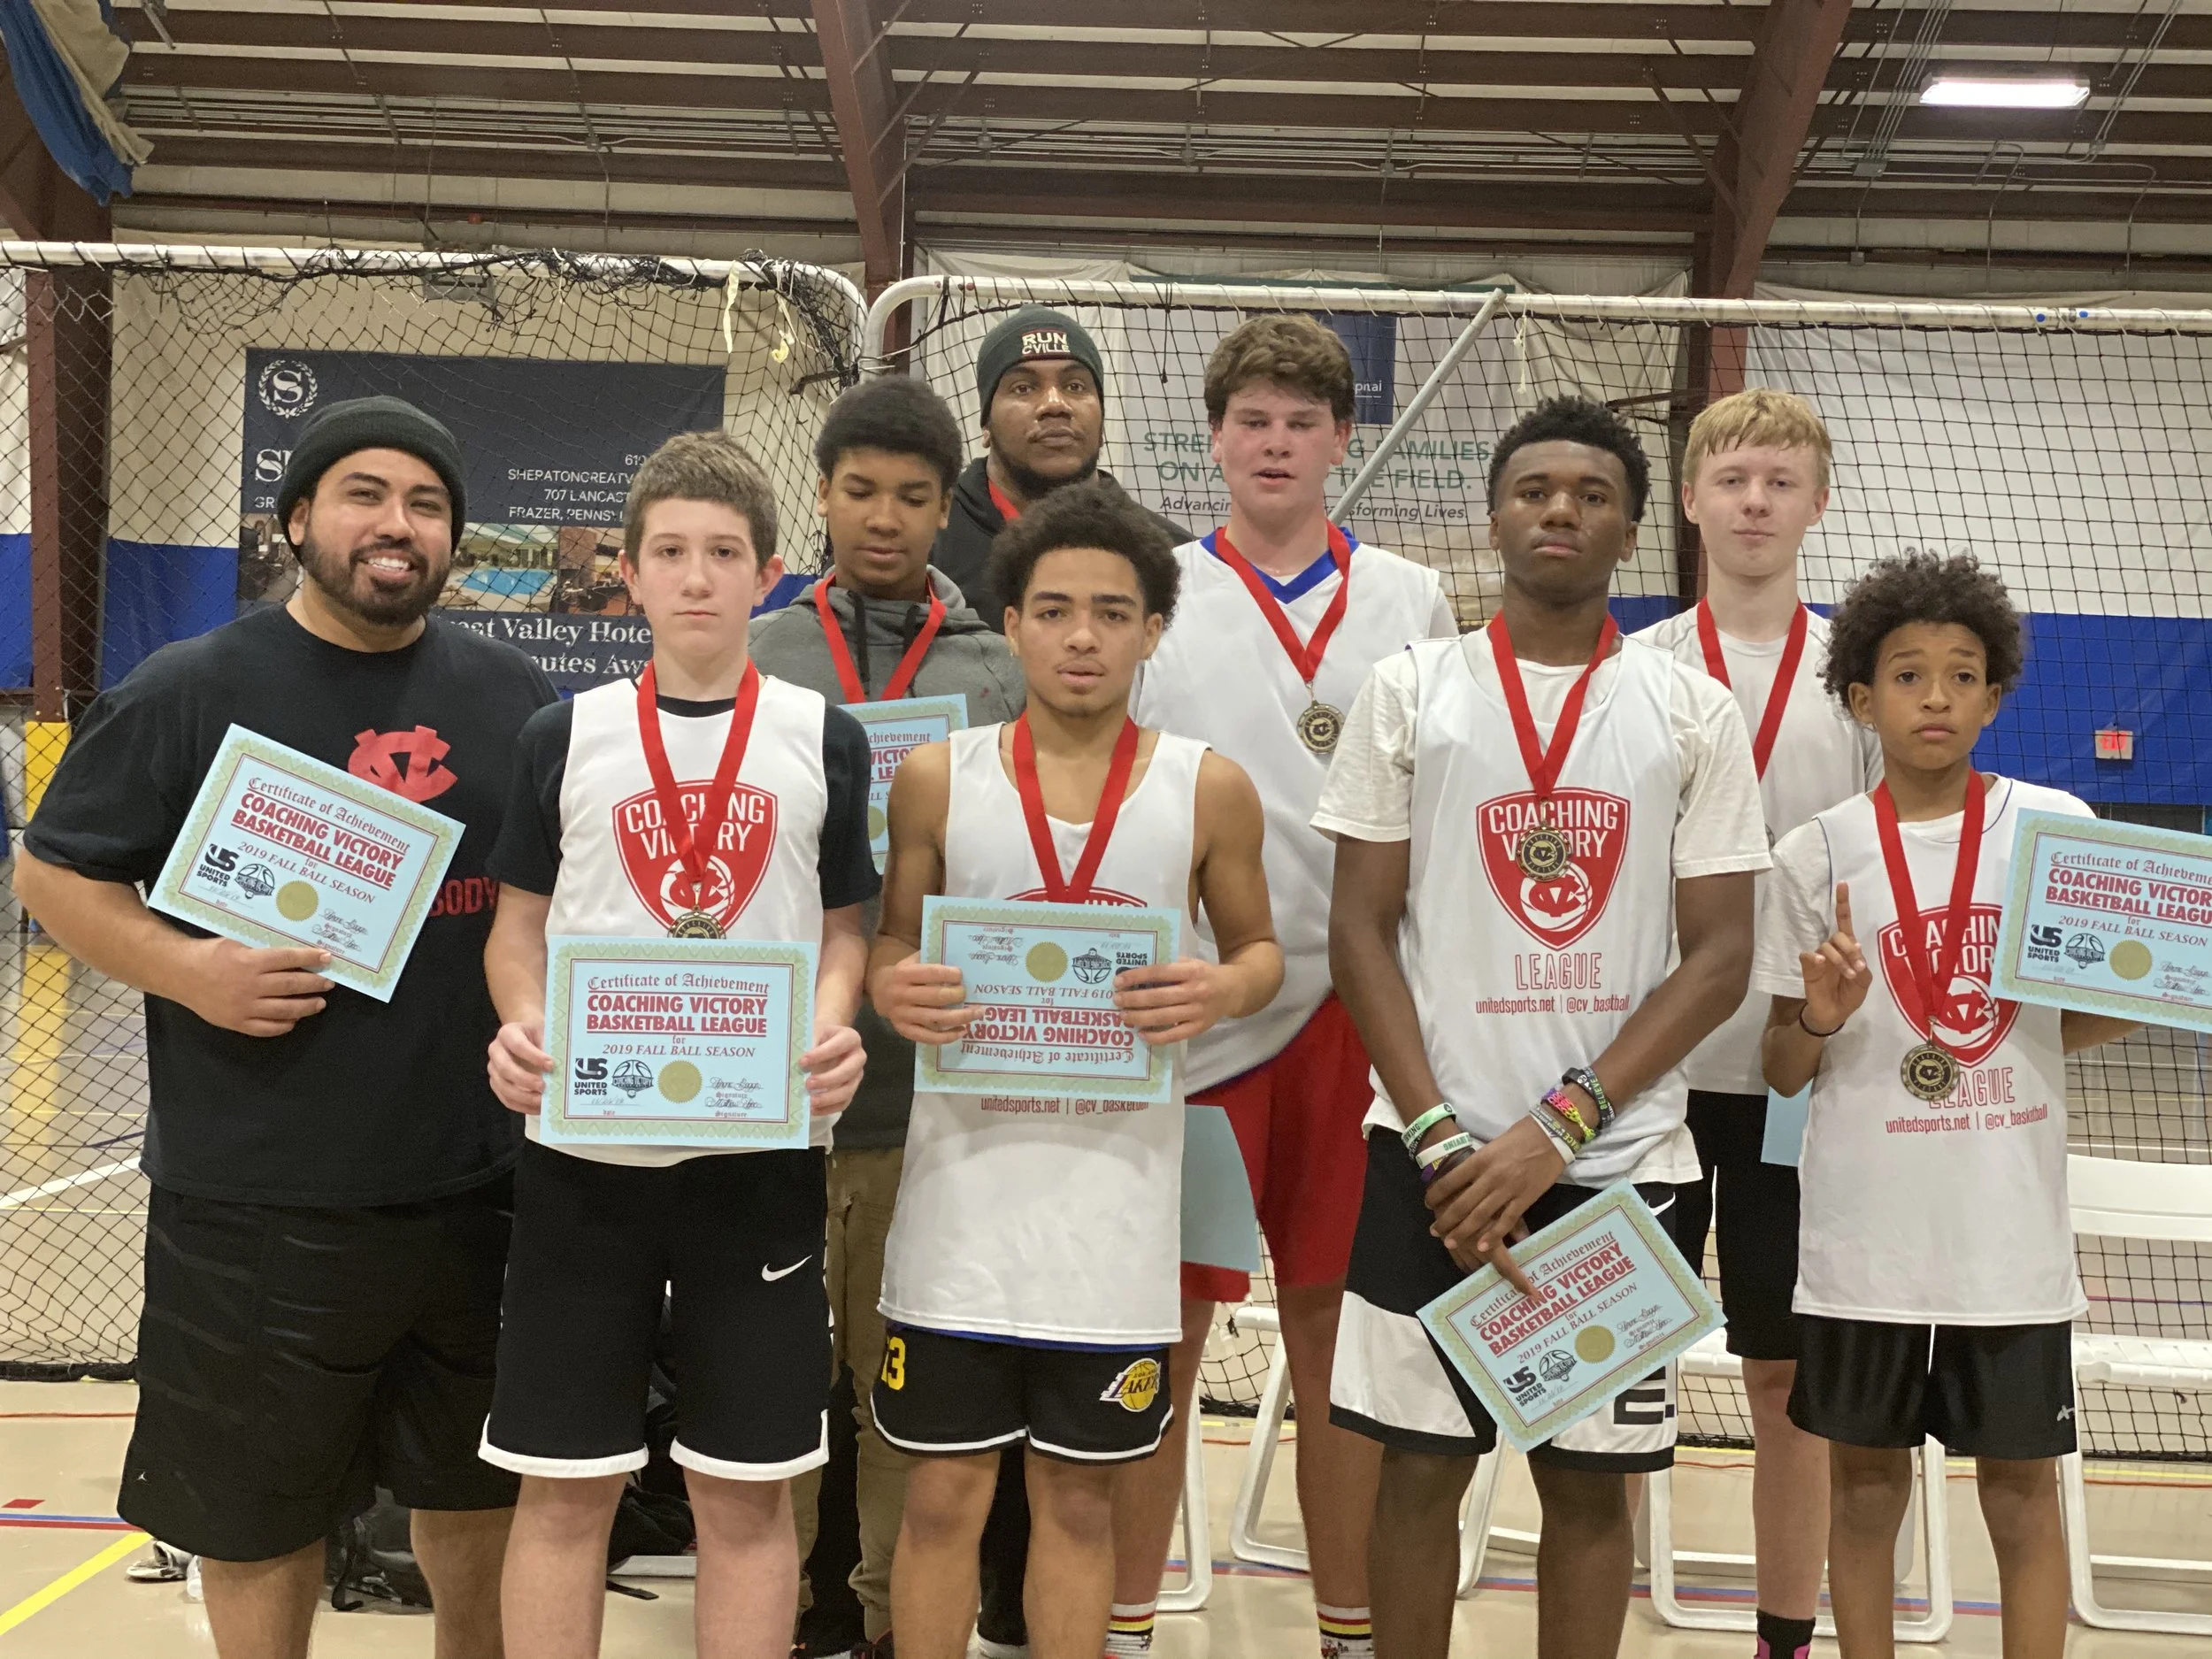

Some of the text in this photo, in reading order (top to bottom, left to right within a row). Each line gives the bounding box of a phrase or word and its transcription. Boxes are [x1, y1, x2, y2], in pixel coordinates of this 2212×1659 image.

[1022, 333, 1067, 346] RUN
[1022, 343, 1071, 354] CVILLE
[273, 370, 303, 403] S
[1159, 461, 1199, 482] ON
[1394, 469, 1472, 490] FIELD.
[544, 489, 567, 501] 707
[509, 506, 564, 521] FRAZER,
[1425, 504, 1469, 518] Lives.
[501, 617, 584, 647] Valley
[588, 621, 652, 643] Hote
[866, 733, 931, 744] chievement
[248, 777, 411, 854] Certificate of Achievement
[1488, 799, 1618, 833] COACHING
[241, 793, 404, 871] COACHING VICTORY
[232, 809, 397, 887] BASKETBALL LEAGUE
[199, 864, 231, 880] UNITED
[237, 841, 375, 903] 2019 FALL BALL SEASON
[2051, 851, 2212, 885] Certificate of Achieveme
[196, 871, 228, 887] SPORTS
[2048, 868, 2212, 907] COACHING VICTOR
[2046, 886, 2212, 926] BASKETBALL LEAGU
[2058, 915, 2208, 947] 2019 FALL BALL SEASON
[2027, 952, 2059, 963] SPORTS
[2028, 946, 2060, 956] UNITED
[1515, 952, 1602, 990] LEAGUE
[588, 973, 769, 994] Certificate of Achievement
[974, 984, 1118, 1000] 019 FALL BALL SEASON
[587, 995, 768, 1016] COACHING VICTORY
[1476, 996, 1555, 1015] unitedsports.net
[587, 1014, 767, 1033] BASKETBALL LEAGUE
[984, 1007, 1135, 1028] ASKETBALL LEAG
[672, 1033, 687, 1044] for
[963, 1023, 1134, 1047] COACHING VICTORY
[602, 1044, 757, 1057] 2019 FALL BALL SEASON
[961, 1043, 1134, 1064] Certificate of Achievement
[980, 1094, 1060, 1115] unitedsports.net
[1590, 1078, 1609, 1110] BELIEVE
[1886, 1113, 1970, 1134] unitedsports.net
[1470, 1288, 1521, 1327] Certifica
[1539, 1230, 1616, 1277] Achievement
[1479, 1284, 1557, 1341] COACHING
[1556, 1241, 1624, 1290] VICTORY
[1488, 1293, 1578, 1356] BASKETBALL
[1577, 1256, 1635, 1299] LEAGUE
[1517, 1342, 1542, 1364] 2019
[1543, 1328, 1570, 1348] FALL
[1570, 1310, 1596, 1331] BALL
[1596, 1282, 1638, 1314] SEASON
[1516, 1382, 1543, 1402] UNITED
[1518, 1387, 1547, 1407] SPORTS
